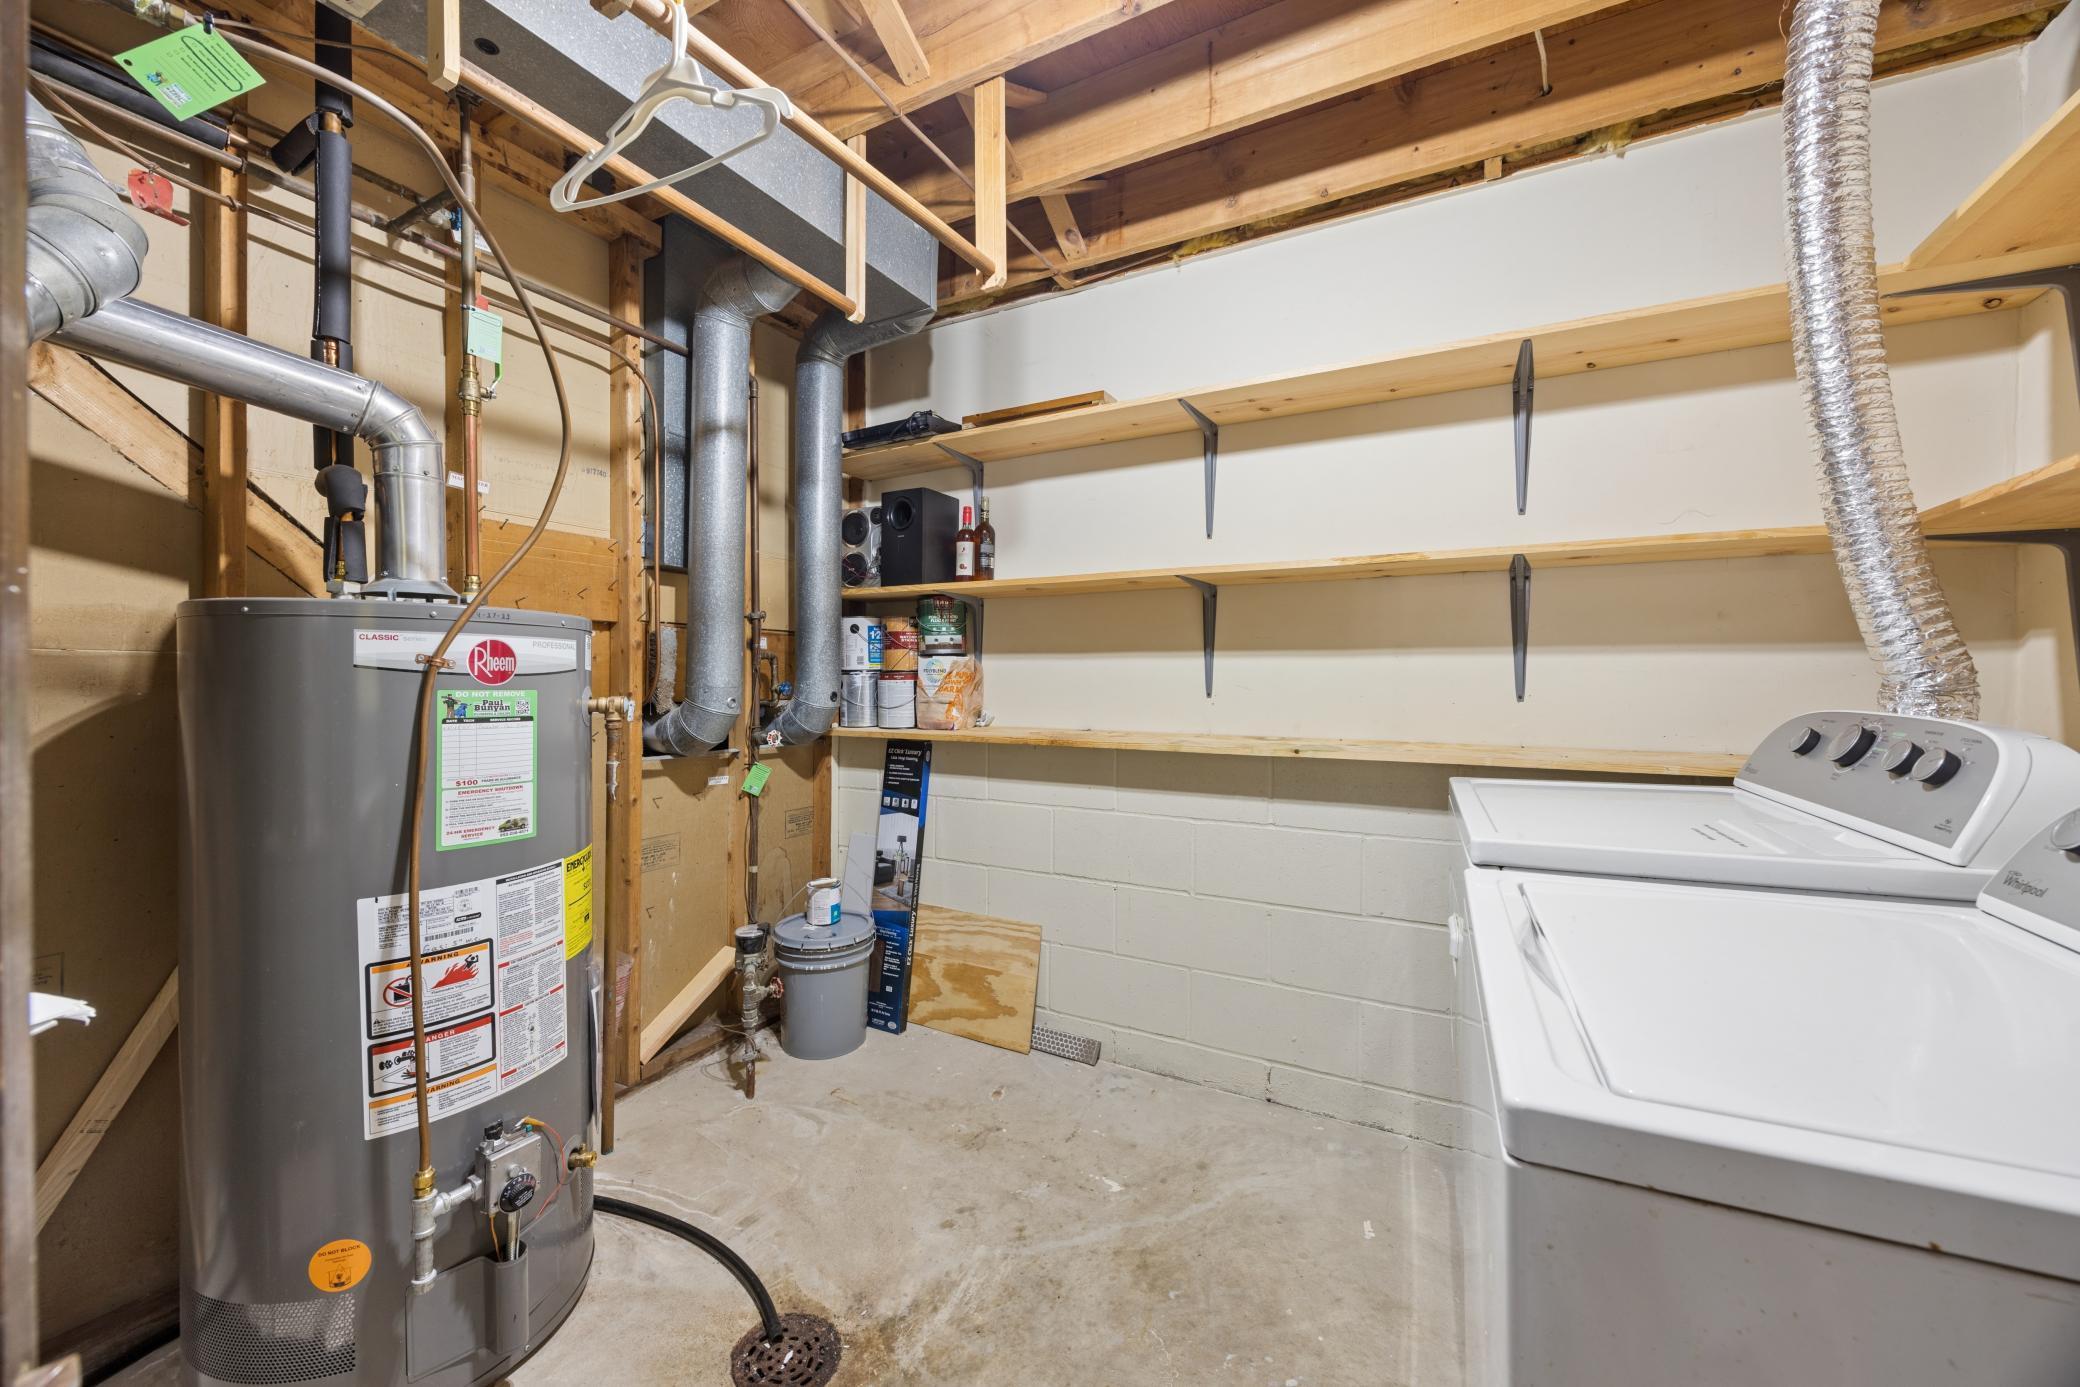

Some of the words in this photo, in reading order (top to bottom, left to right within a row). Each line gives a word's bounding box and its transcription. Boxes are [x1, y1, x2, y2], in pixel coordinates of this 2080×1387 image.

[358, 633, 399, 641] CLASSIC
[532, 640, 576, 651] PROFESSIONAL
[474, 640, 515, 677] Rheem
[493, 690, 526, 698] REMOVE
[474, 704, 511, 712] Bunyan
[456, 779, 478, 787] $100
[457, 788, 493, 796] EMERGENCY
[2003, 874, 2049, 898] Whirlpool
[425, 1029, 455, 1042] ANGER
[327, 1248, 340, 1256] NOT
[340, 1245, 361, 1253] BLOCK
